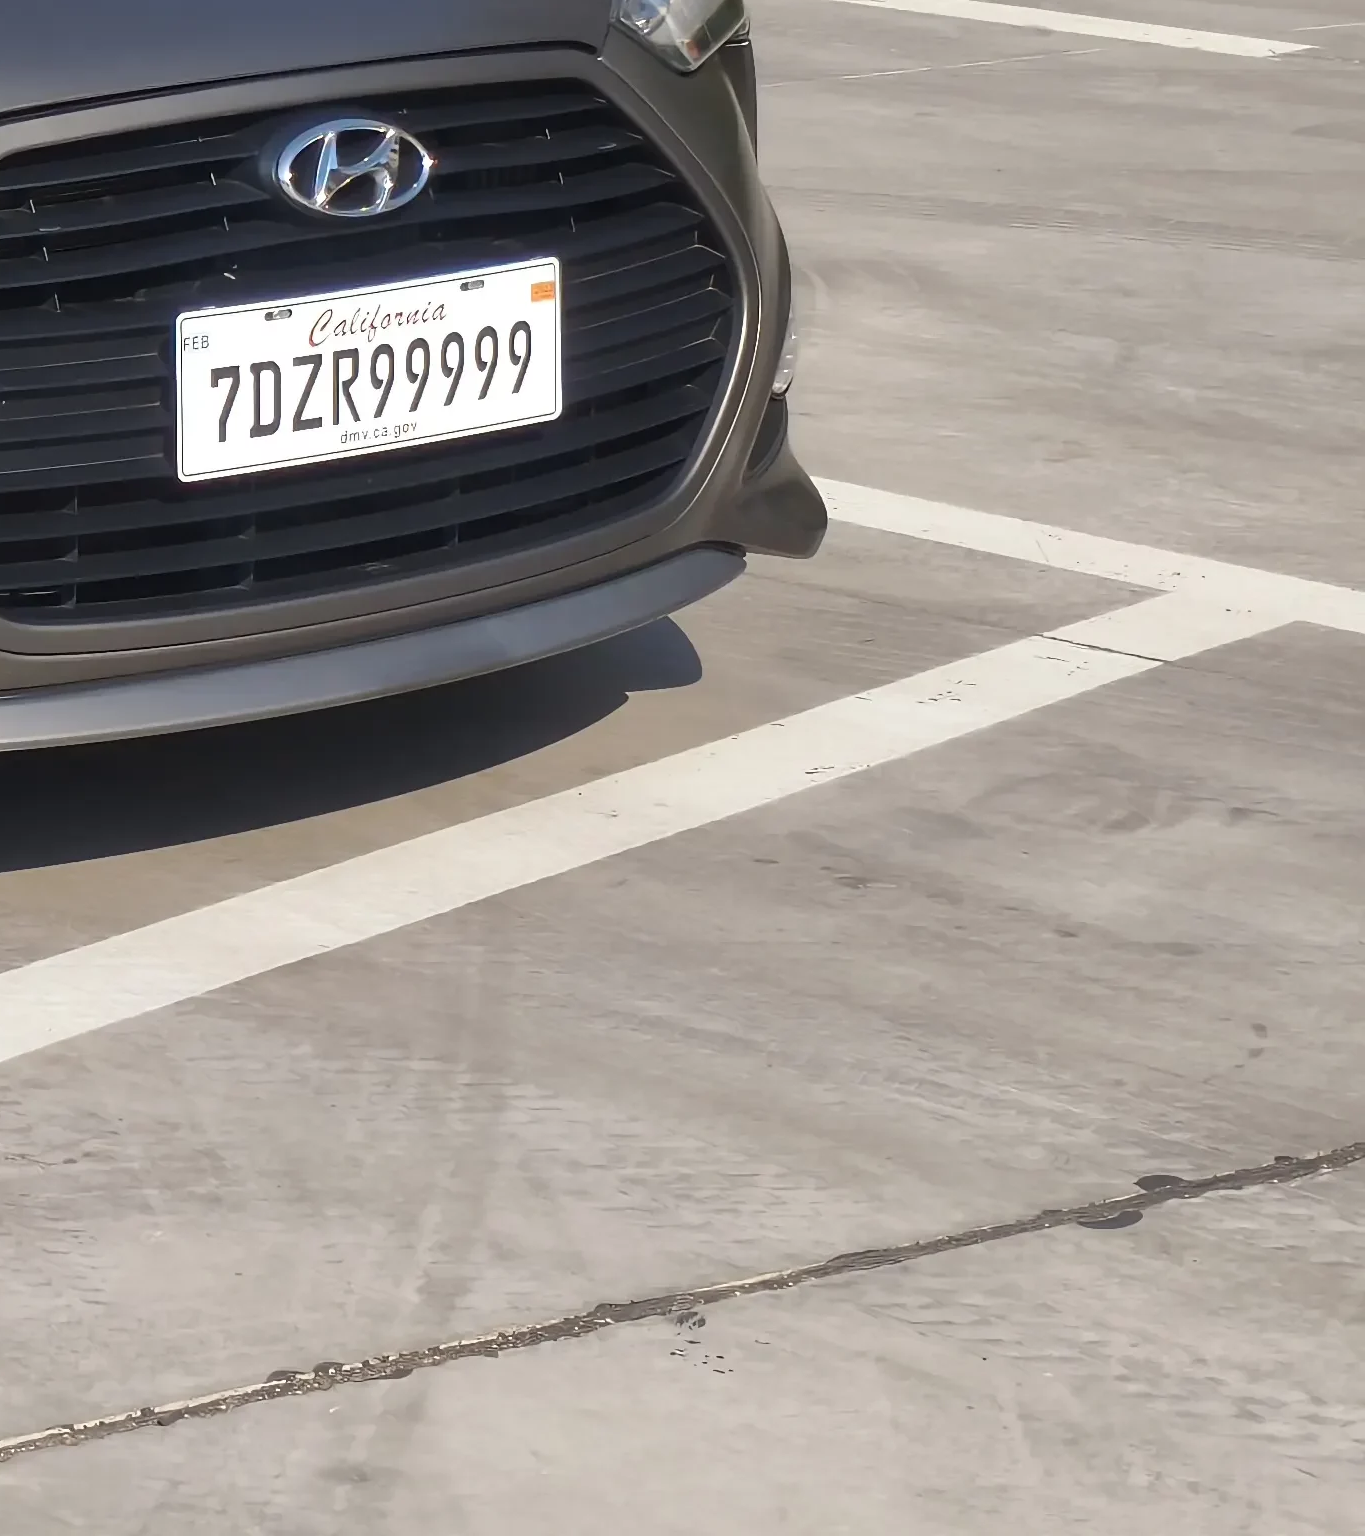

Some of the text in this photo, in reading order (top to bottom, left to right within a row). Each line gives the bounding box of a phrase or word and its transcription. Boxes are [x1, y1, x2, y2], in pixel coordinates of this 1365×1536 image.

[308, 301, 447, 348] California
[183, 334, 210, 352] FEB
[210, 320, 532, 443] 7DZR99999
[340, 421, 418, 445] dmv.ca.gov
